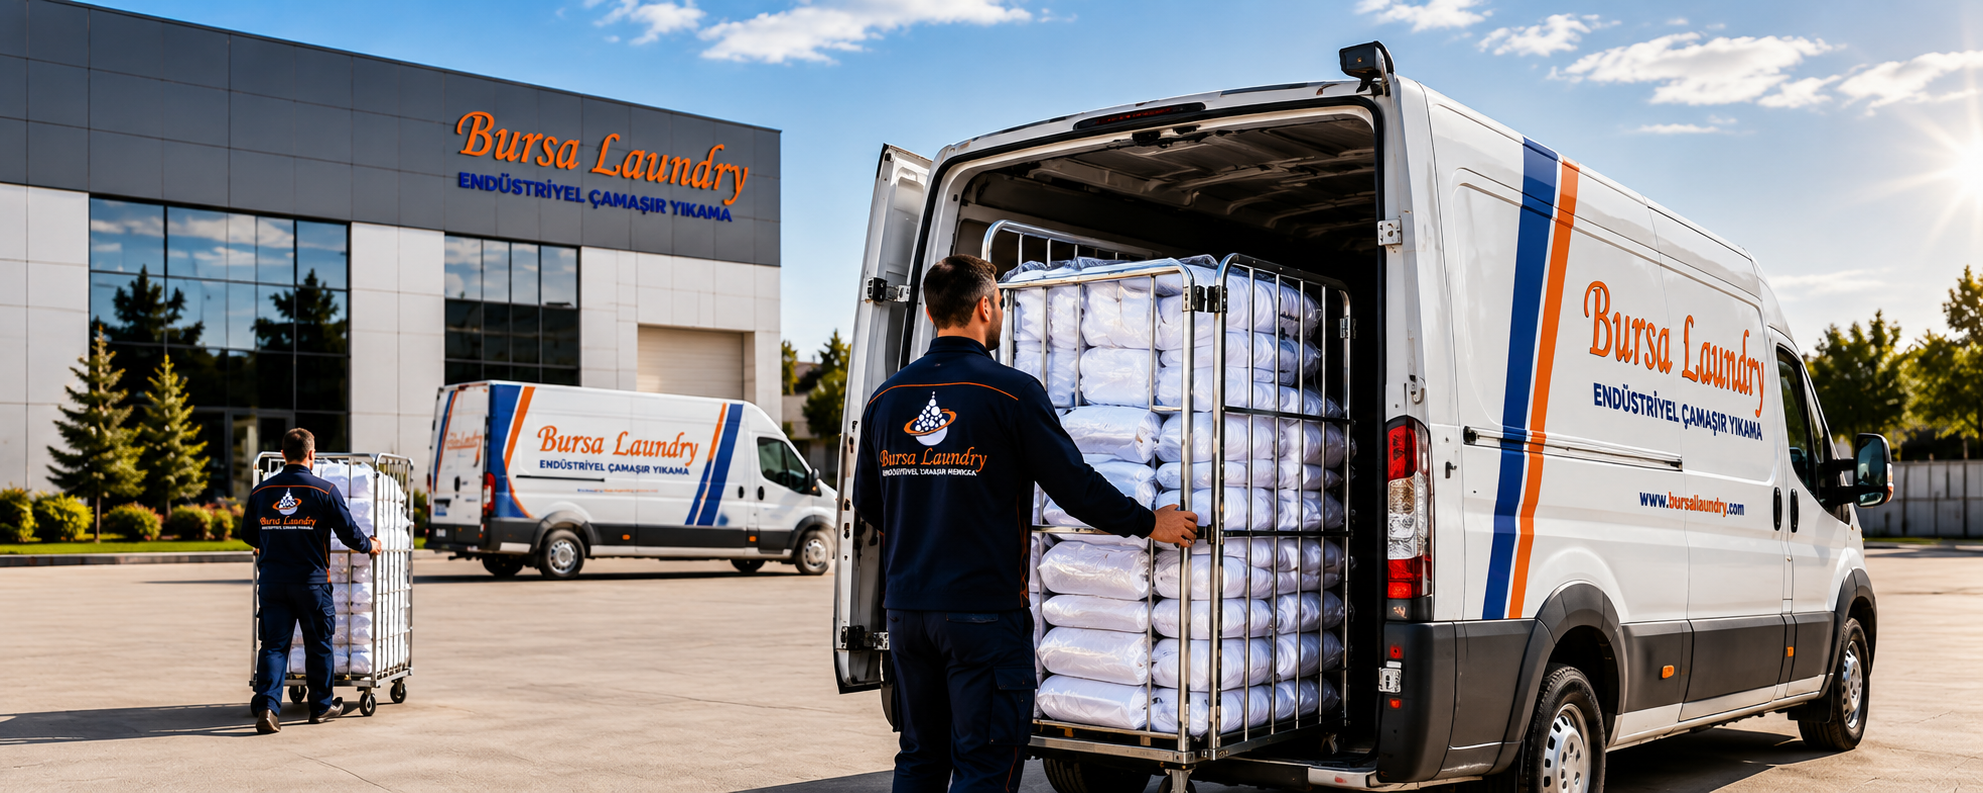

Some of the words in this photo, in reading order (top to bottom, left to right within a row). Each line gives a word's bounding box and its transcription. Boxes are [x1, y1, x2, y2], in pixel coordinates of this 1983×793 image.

[456, 111, 580, 170] Bursa
[591, 133, 749, 206] Laundry
[458, 171, 586, 204] ENDÜSTRİYEL
[588, 189, 667, 215] ÇAMAŞIR
[669, 199, 733, 222] YIKAMA
[1583, 280, 1674, 375] Bursa
[1681, 314, 1765, 418] Laundry
[1593, 382, 1680, 423] ENDÜSTRİYEL
[1681, 404, 1727, 436] ÇAMAŞIR
[1728, 415, 1763, 441] YIKAMA
[537, 425, 605, 455] Bursa
[612, 431, 699, 467] Laundry
[539, 459, 606, 472] ENDÜSTRİYEL
[607, 463, 650, 474] ÇAMAŞIR
[652, 466, 690, 475] YIKAMA
[879, 449, 917, 467] Bursa
[920, 447, 988, 473] Laundry
